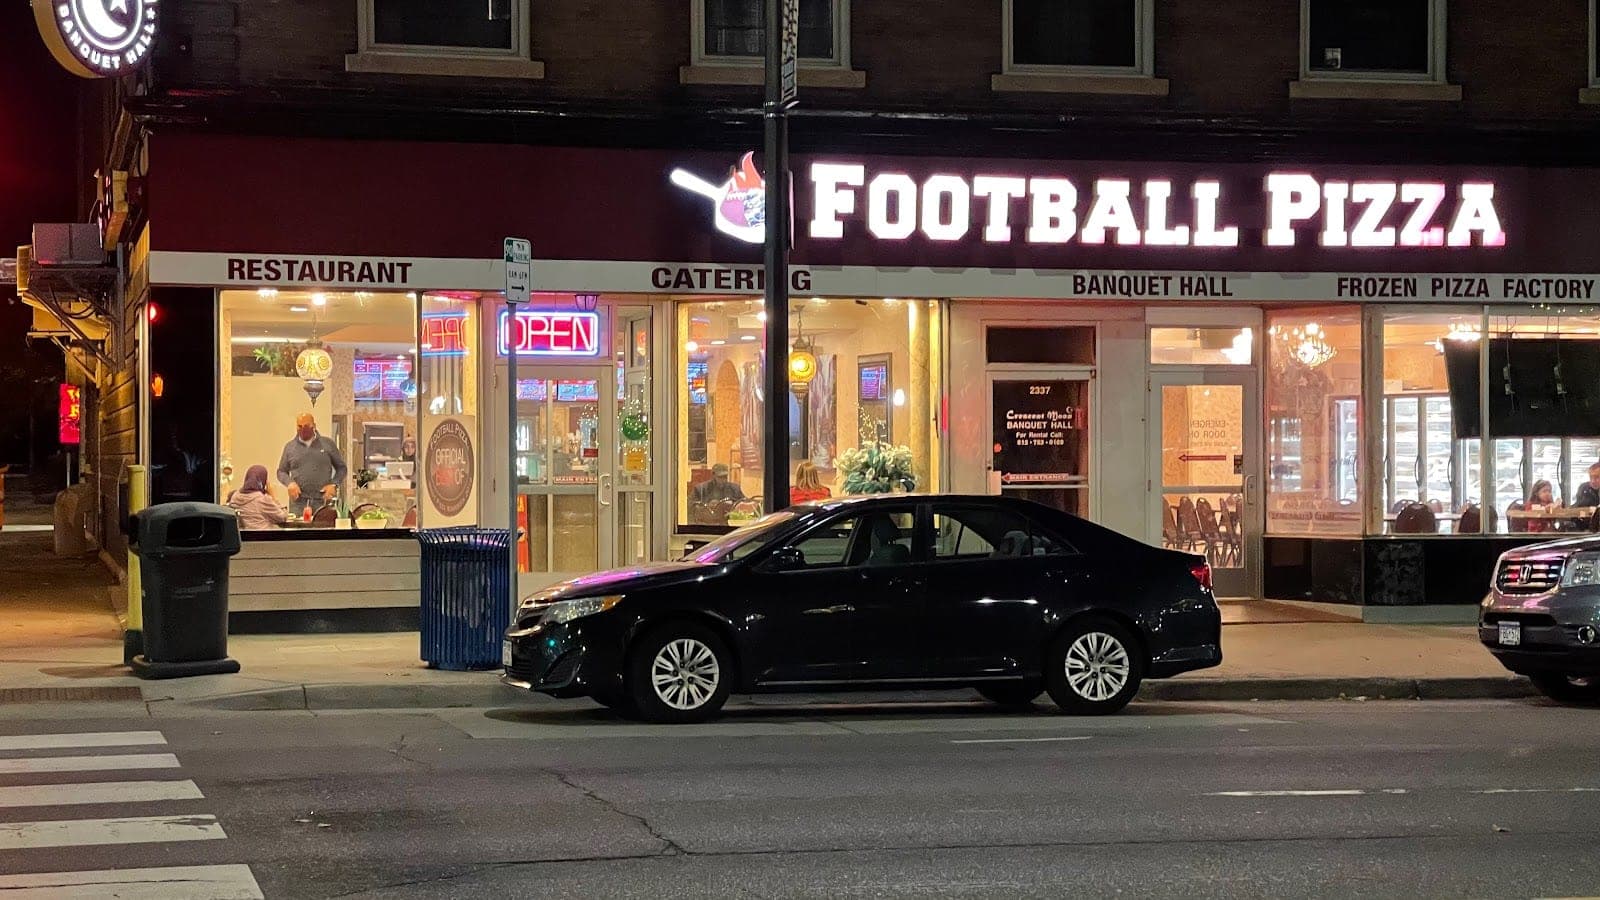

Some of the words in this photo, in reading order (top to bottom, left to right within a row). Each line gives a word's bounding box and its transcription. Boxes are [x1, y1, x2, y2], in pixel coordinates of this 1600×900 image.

[58, 4, 121, 70] BANQUET
[810, 162, 1238, 248] FOOTBALL
[1265, 171, 1506, 249] PIZZA
[227, 257, 413, 285] RESTAURANT
[651, 266, 812, 292] CATERIG
[1072, 274, 1172, 297] BANQUET
[1179, 276, 1233, 297] HALL
[1337, 277, 1417, 297] FROZEN
[1431, 278, 1490, 298] PIZZA
[1503, 278, 1595, 299] FACTORY
[506, 316, 594, 351] OPEN
[1029, 386, 1051, 395] 2337
[1006, 421, 1047, 430] BANQUET
[1050, 421, 1073, 430] HALL
